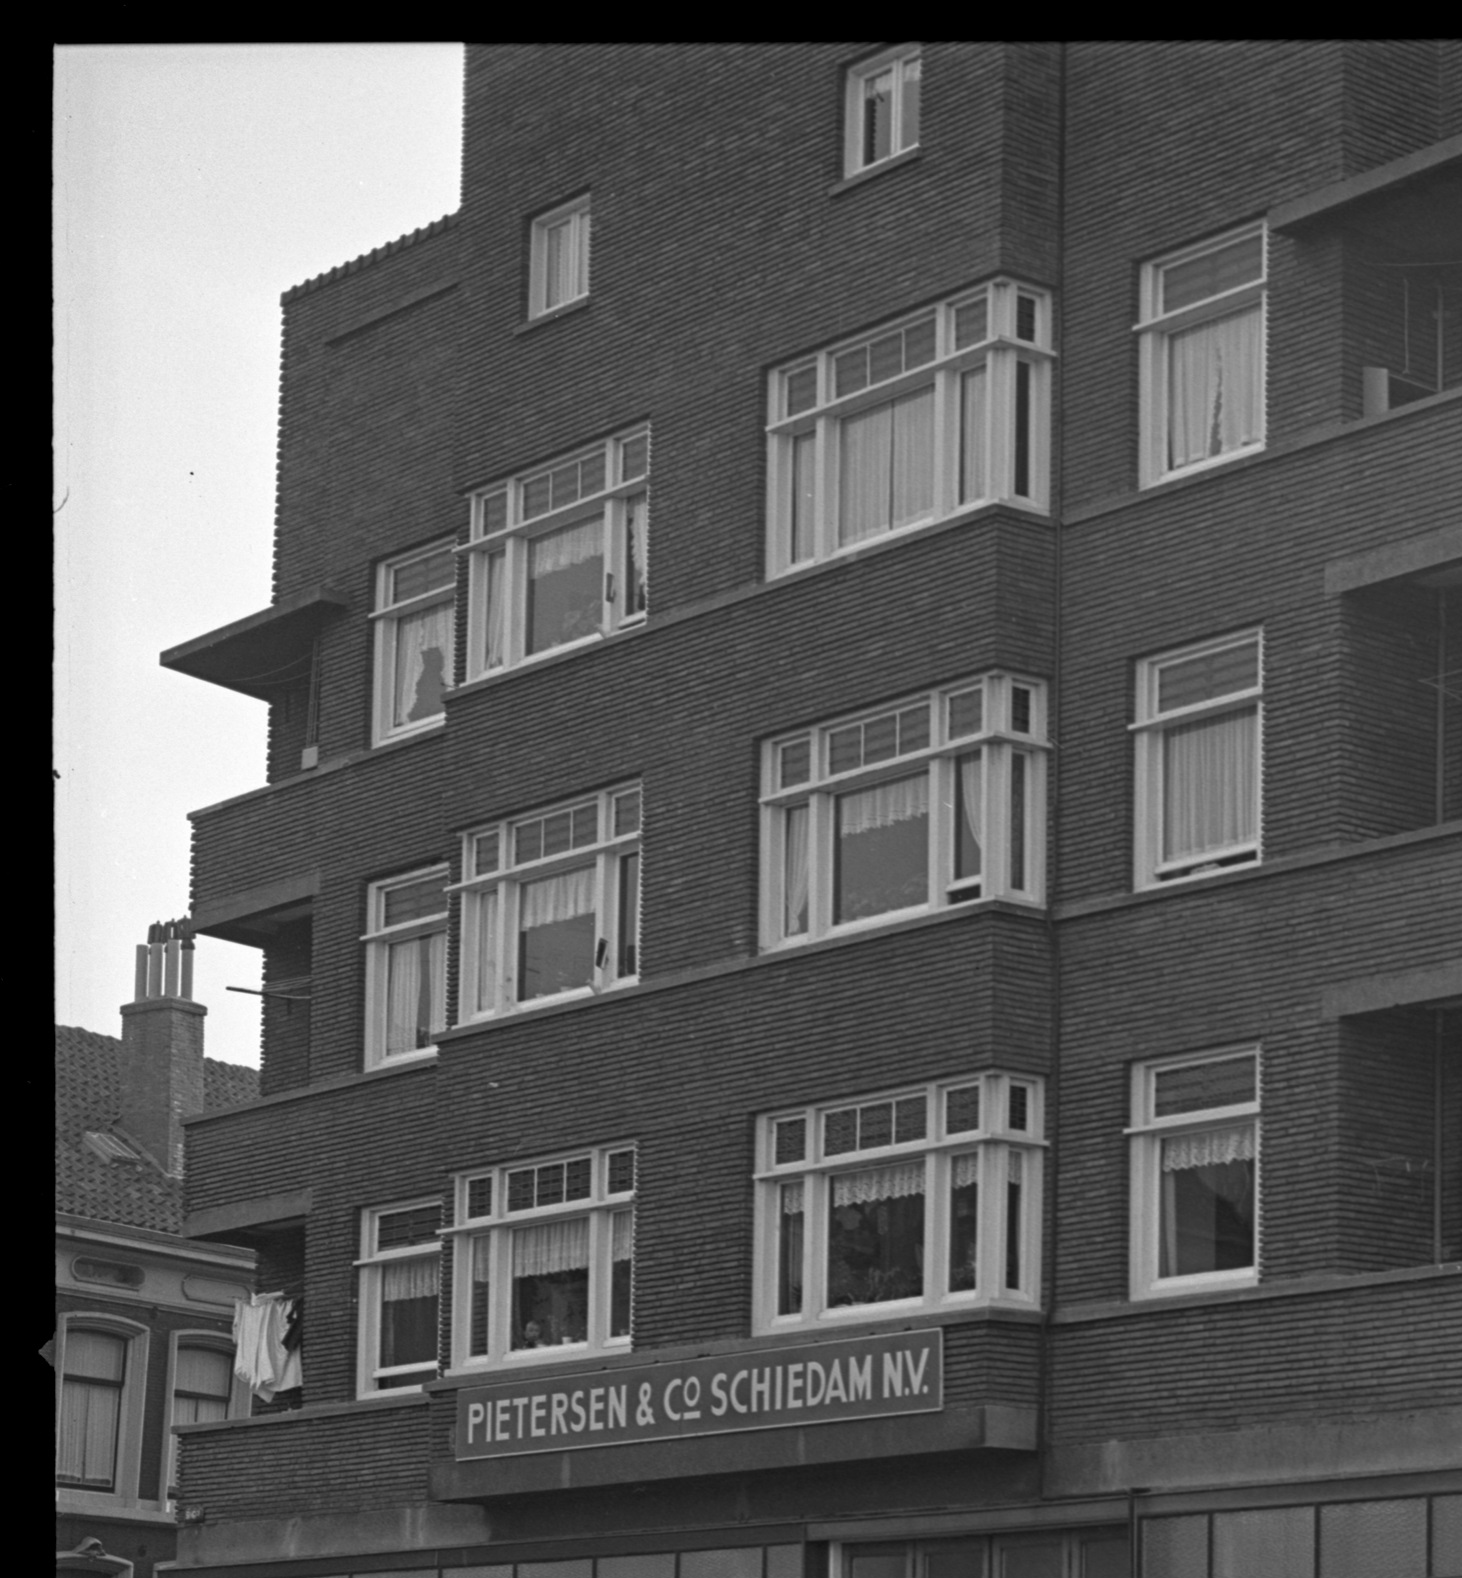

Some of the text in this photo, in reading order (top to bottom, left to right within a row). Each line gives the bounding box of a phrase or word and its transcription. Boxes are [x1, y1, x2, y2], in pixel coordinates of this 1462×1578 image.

[466, 1385, 627, 1445] PIETERSEN
[636, 1382, 656, 1426] &
[710, 1354, 873, 1417] SCHIEDAM
[882, 1348, 930, 1398] N.V.
